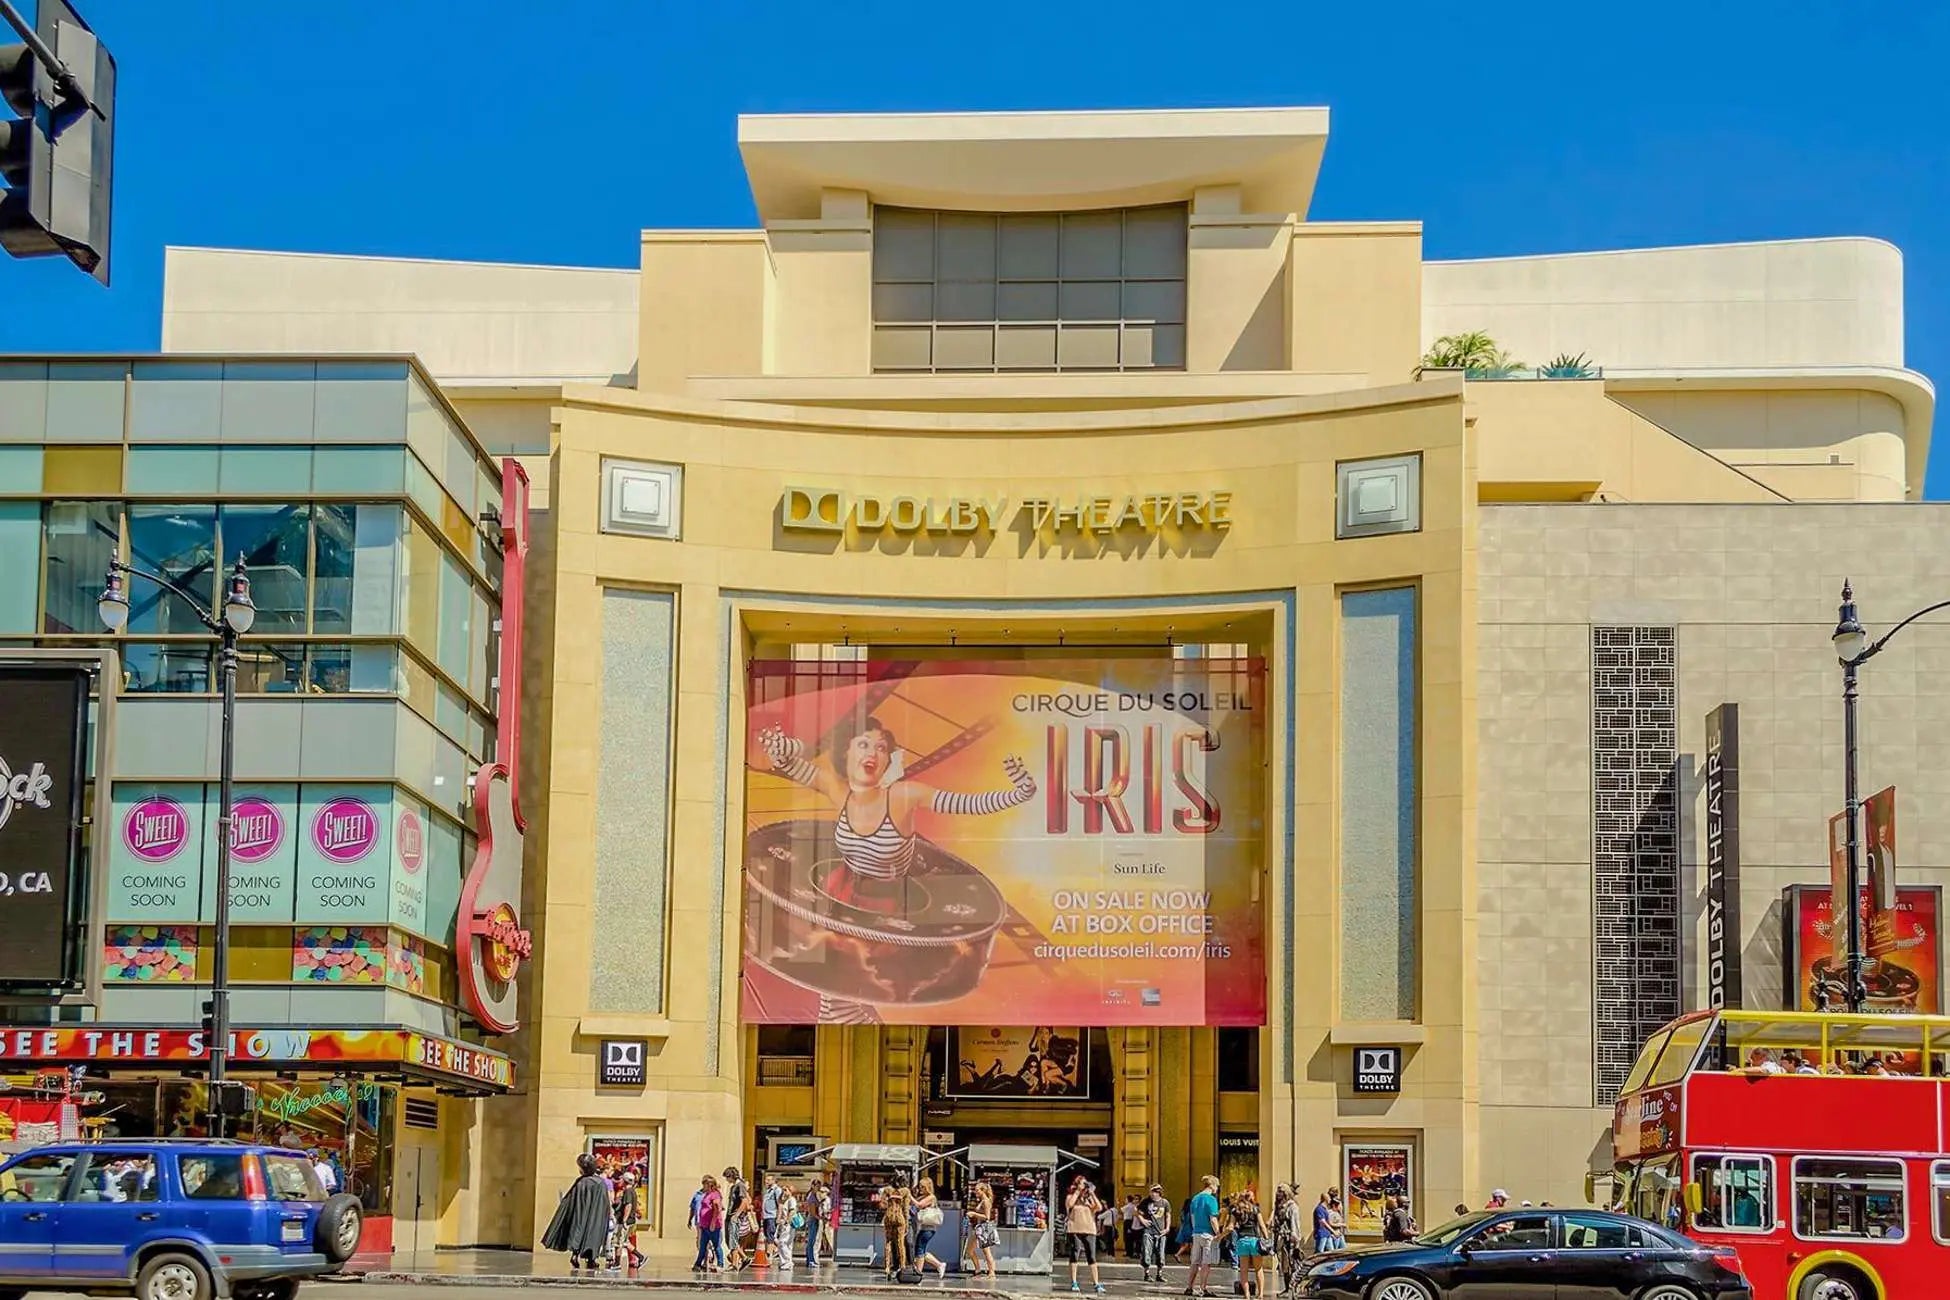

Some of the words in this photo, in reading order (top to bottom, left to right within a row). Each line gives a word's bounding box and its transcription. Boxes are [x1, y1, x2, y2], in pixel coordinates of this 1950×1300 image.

[854, 495, 1007, 533] DOLBY
[1020, 489, 1234, 534] THEATRE
[1012, 693, 1108, 718] CIRQUE
[1118, 692, 1153, 712] DU
[1163, 692, 1253, 712] SOLEIL
[1046, 723, 1222, 834] IRIS
[1708, 730, 1722, 889] THEATRE
[136, 811, 177, 848] SWEET!
[230, 811, 272, 848] SWEET!
[325, 811, 367, 849] SWEET!
[1114, 863, 1138, 875] Sun
[1142, 863, 1166, 875] Life
[20, 872, 53, 893] CA
[122, 876, 186, 889] COMING
[229, 876, 280, 889] OMING
[311, 876, 376, 889] COMING
[131, 894, 176, 907] SOON
[320, 894, 365, 907] SOON
[1054, 891, 1088, 911] ON
[1095, 891, 1144, 911] SALE
[1151, 891, 1210, 911] NOW
[1052, 915, 1078, 934] AT
[1086, 915, 1133, 934] BOX
[1138, 914, 1213, 935] OFFICE
[1034, 941, 1231, 962] cirquedusoleil.com/iris
[1711, 898, 1725, 1011] DOLBY
[85, 1032, 160, 1057] THE
[188, 1032, 312, 1057] SOW
[417, 1038, 441, 1066] SEE
[446, 1043, 470, 1073] THE
[607, 1067, 640, 1076] DOLBY
[1360, 1075, 1394, 1084] DOLBY
